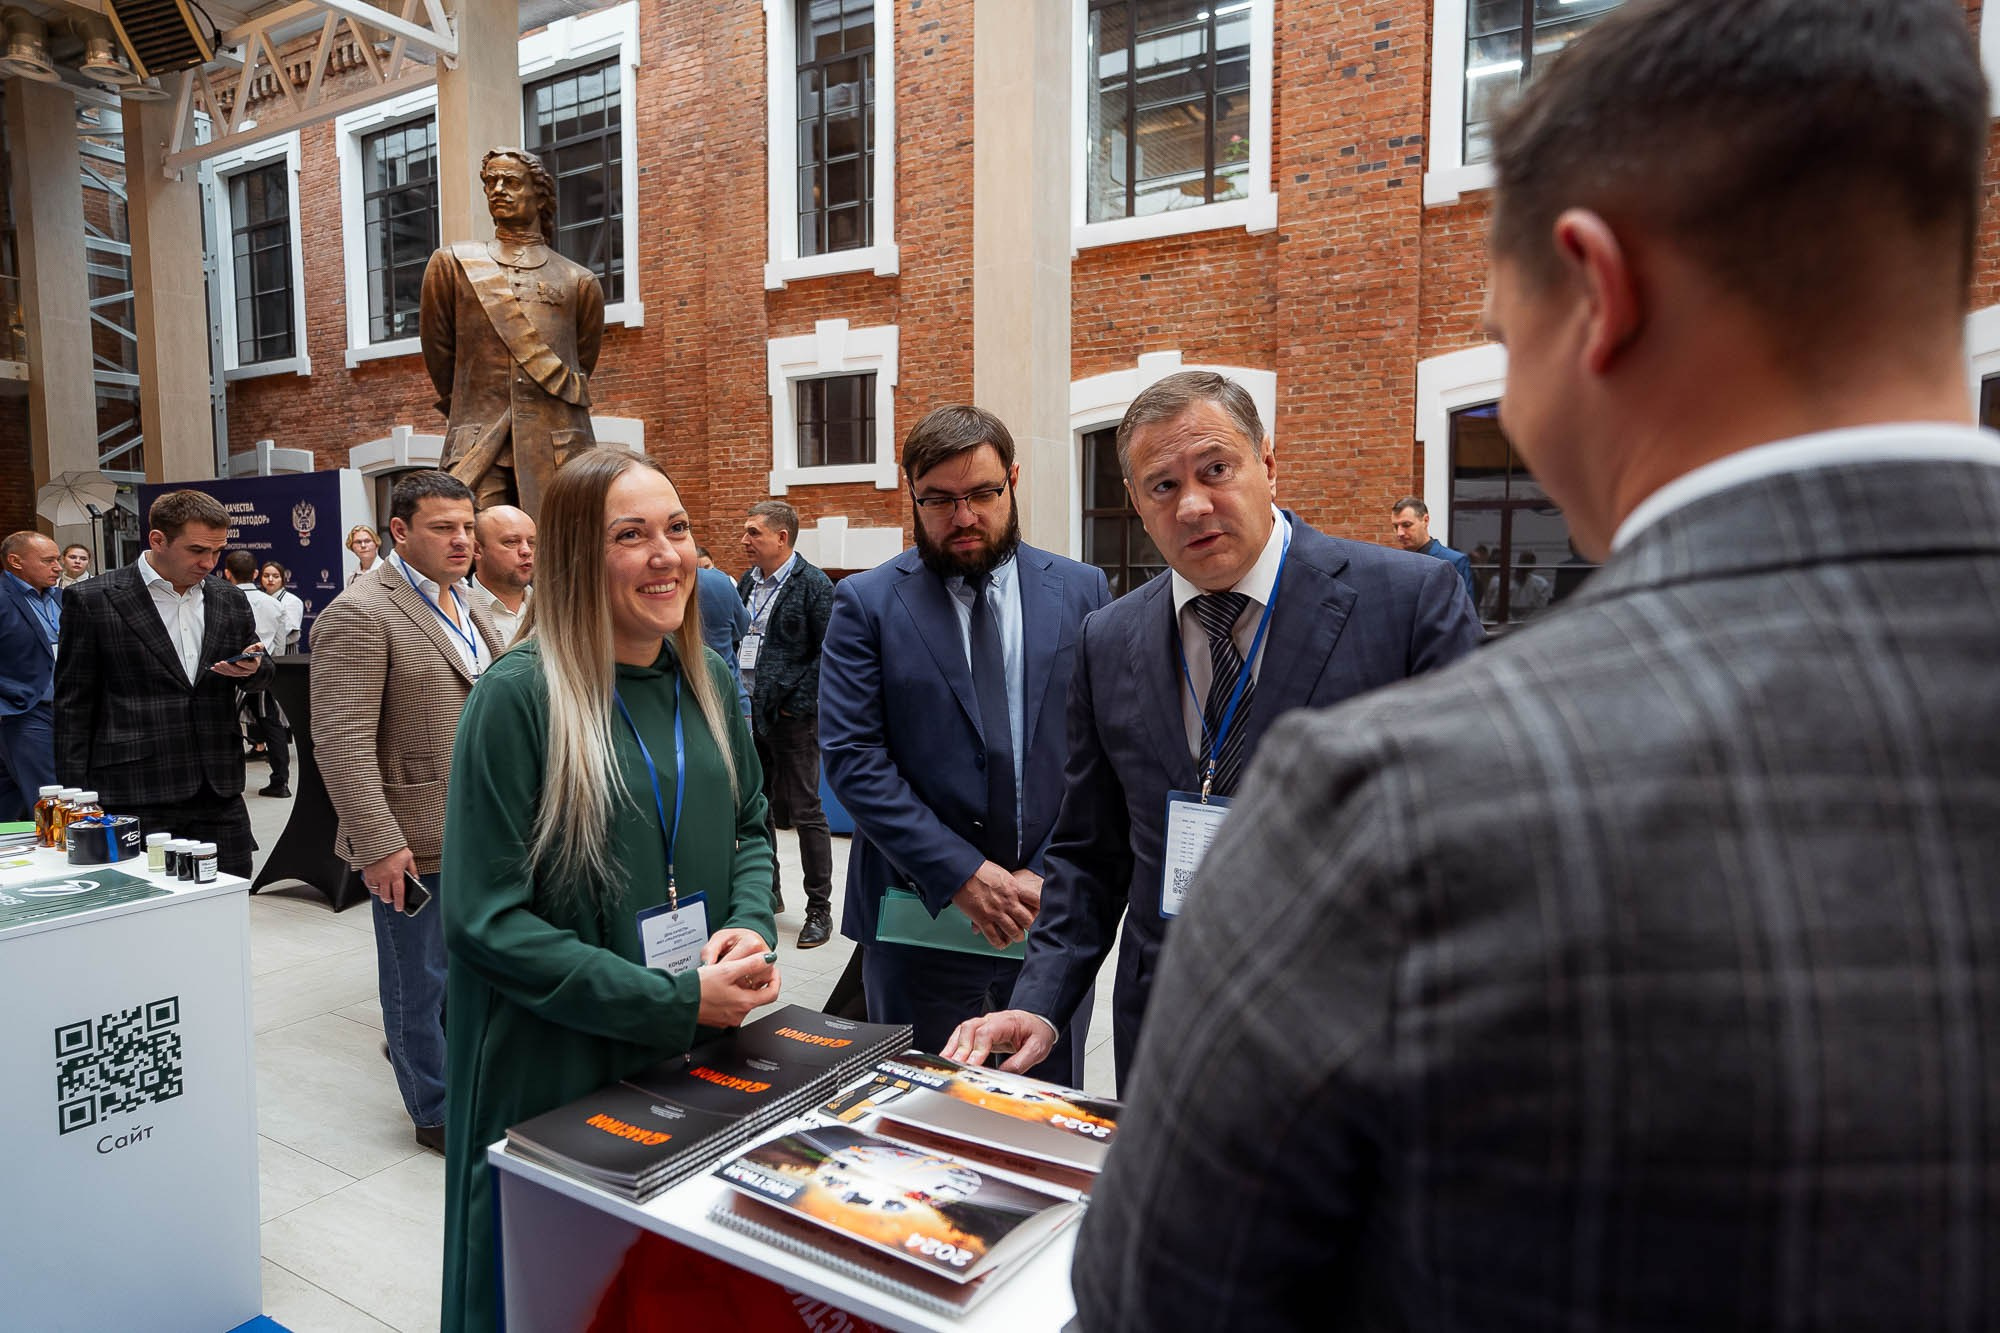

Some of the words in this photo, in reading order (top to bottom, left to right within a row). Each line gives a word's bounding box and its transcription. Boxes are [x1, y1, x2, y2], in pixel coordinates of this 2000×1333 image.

[230, 515, 269, 526] ПРАВТОДОР»
[774, 1026, 834, 1047] БАСТИОН
[689, 1065, 754, 1090] БАСТИОН
[585, 1113, 650, 1144] БАСТИОН
[1050, 1113, 1112, 1138] 2024
[96, 1124, 155, 1155] Сайт
[905, 1232, 974, 1267] 2024
